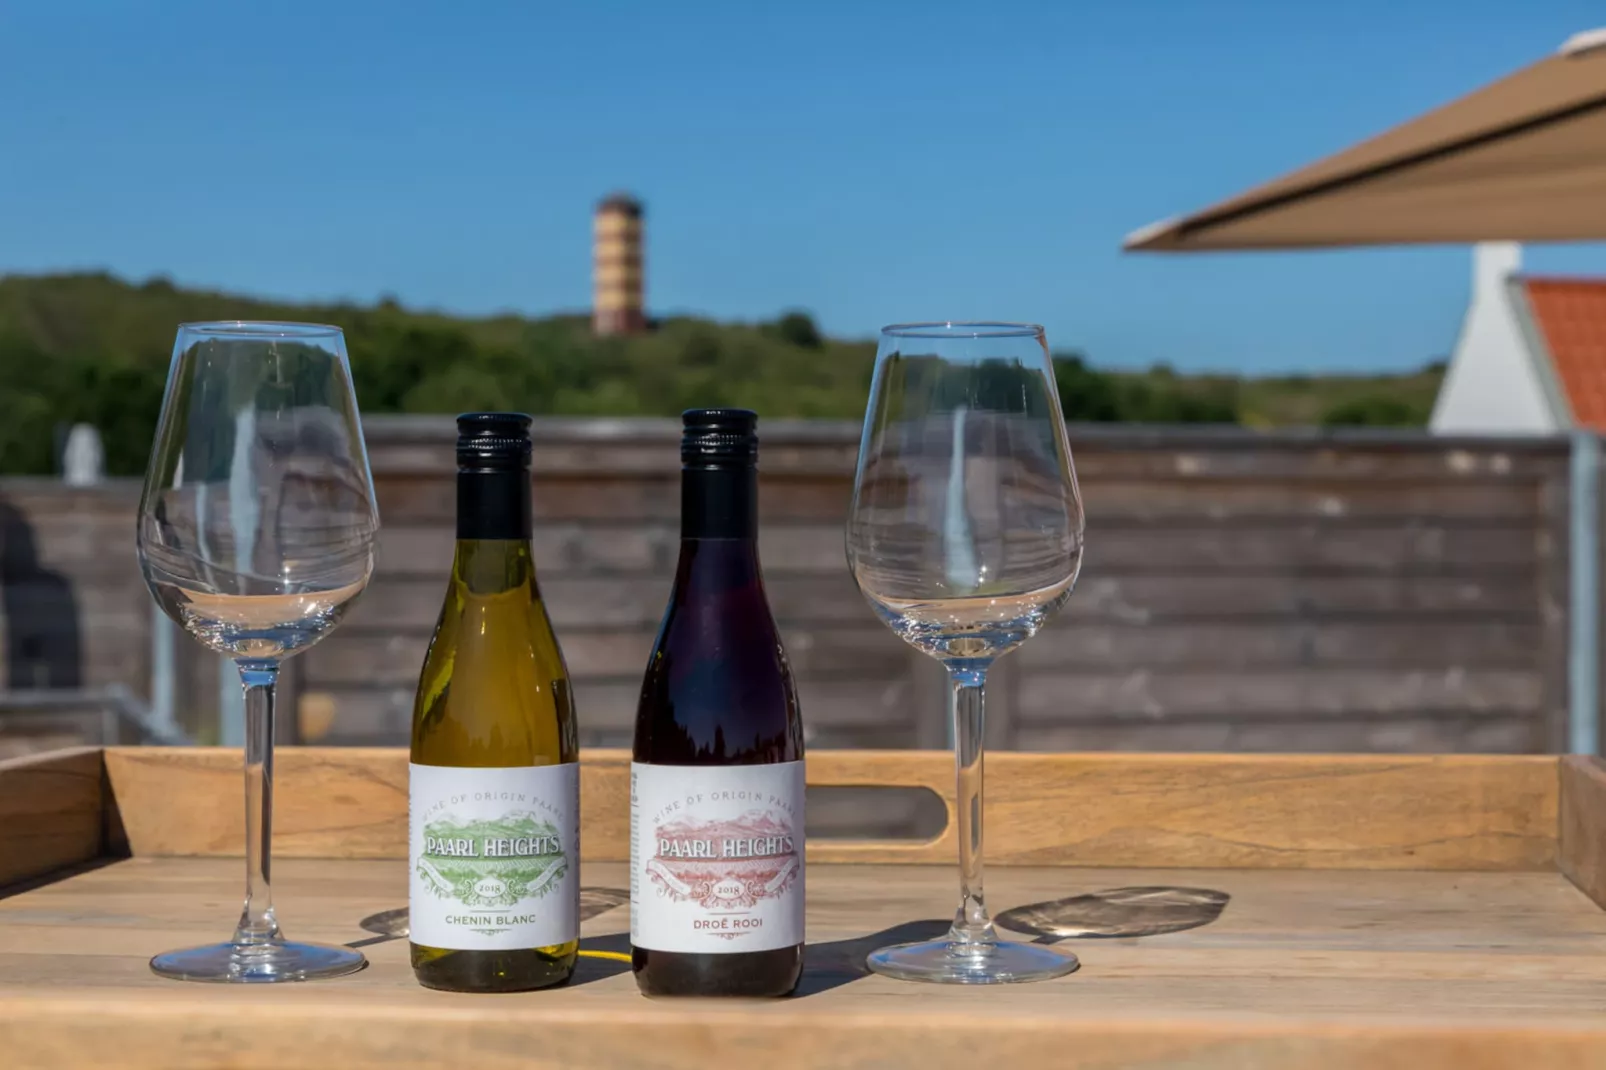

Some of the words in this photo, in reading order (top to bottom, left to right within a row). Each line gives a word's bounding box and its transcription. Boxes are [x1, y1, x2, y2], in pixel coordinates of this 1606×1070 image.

[452, 794, 467, 804] OF
[474, 791, 526, 802] ORIGIN
[653, 800, 680, 824] WINE
[686, 794, 703, 805] OF
[711, 791, 763, 801] ORIGIN
[427, 836, 479, 857] PAARL
[484, 835, 561, 857] HEIGHTS
[660, 838, 717, 858] PAARL
[722, 836, 794, 857] HEIGHTS
[479, 884, 501, 893] 2018
[718, 886, 740, 895] 2018
[445, 914, 492, 926] CHENIN
[496, 914, 536, 925] BLANC
[693, 918, 728, 930] DROË
[733, 918, 763, 929] ROOI
